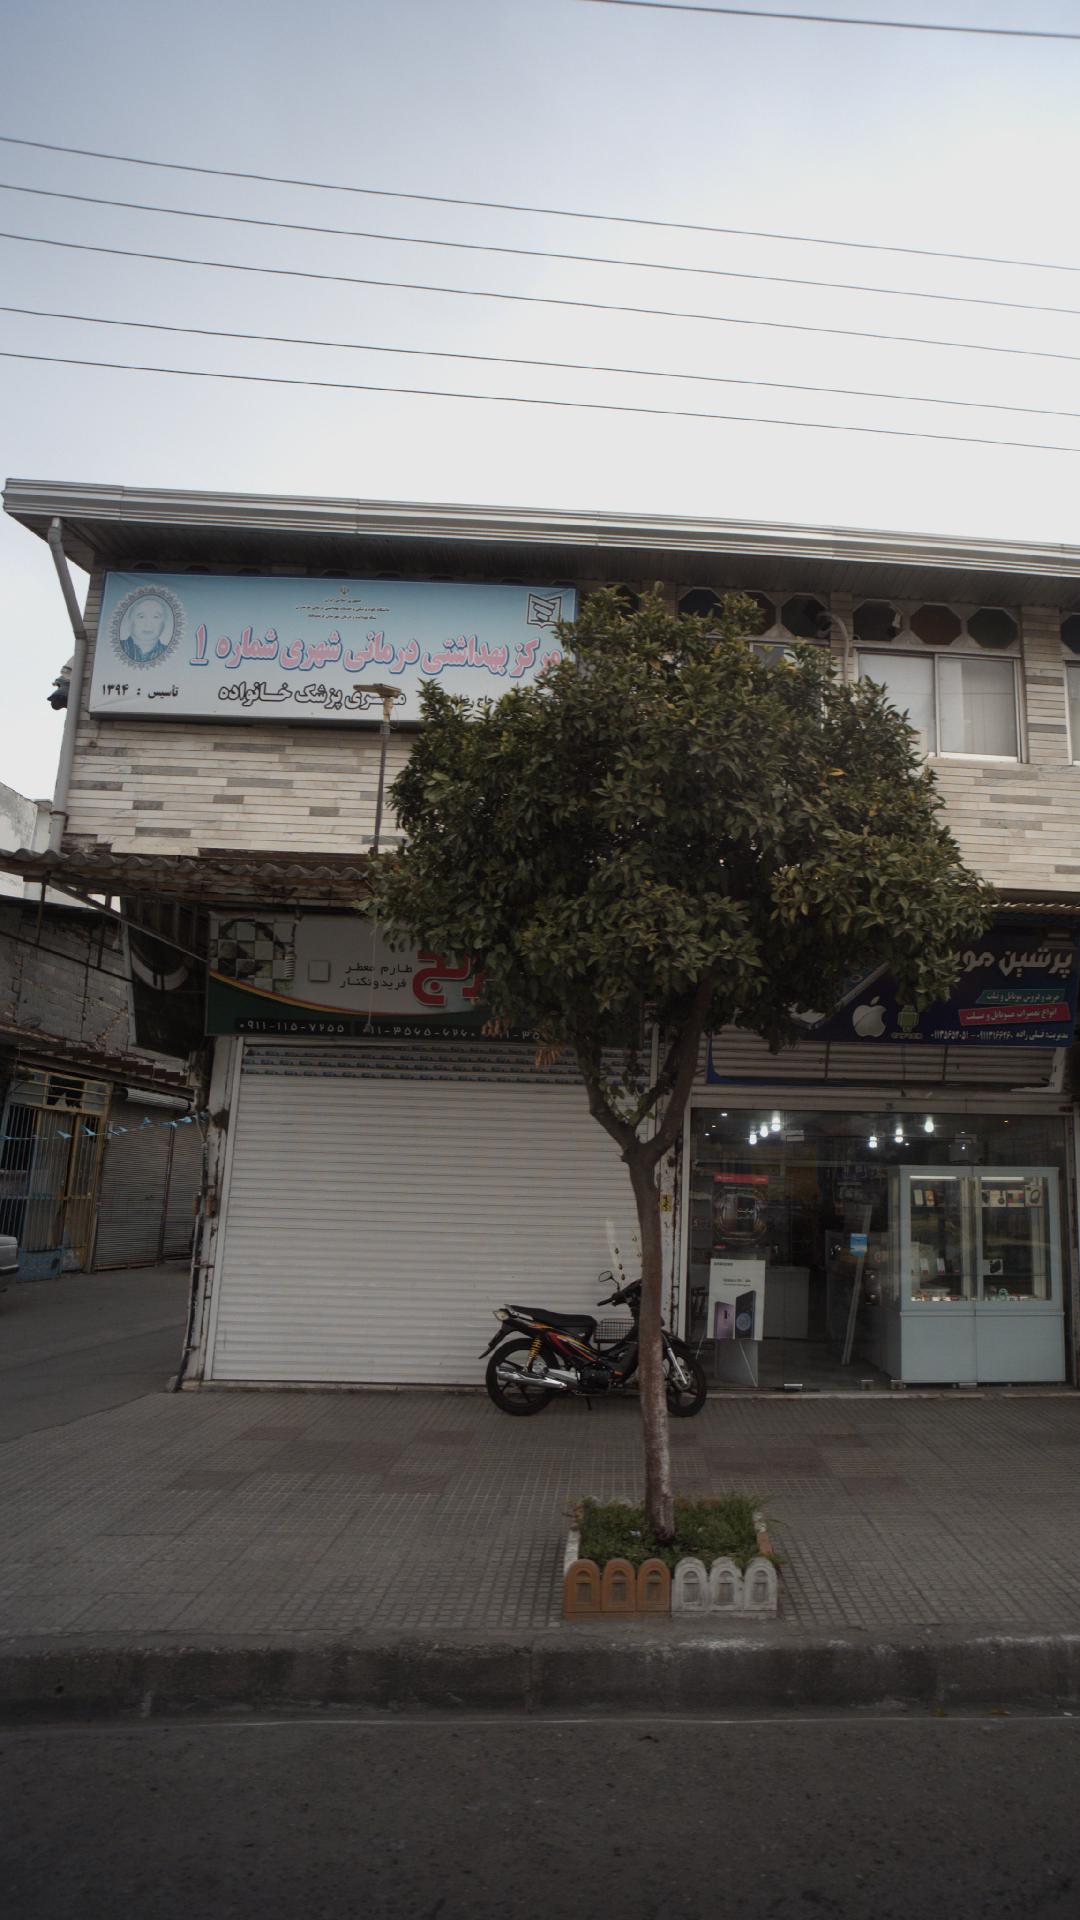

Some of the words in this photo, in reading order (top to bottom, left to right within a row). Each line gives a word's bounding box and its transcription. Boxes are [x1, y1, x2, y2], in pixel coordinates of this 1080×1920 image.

[215, 626, 279, 668] شماره
[279, 629, 342, 671] شهری
[344, 631, 420, 674] درمانی
[421, 634, 509, 675] بهداشتی
[102, 684, 129, 696] ۱۳۹۴
[148, 684, 180, 699] تأسیس
[218, 681, 293, 706] خانواده
[294, 684, 342, 709] پزشک
[344, 688, 406, 710] مری
[380, 963, 413, 976] طارم
[998, 947, 1073, 979] پرشین
[339, 976, 408, 990] فریدونکنار
